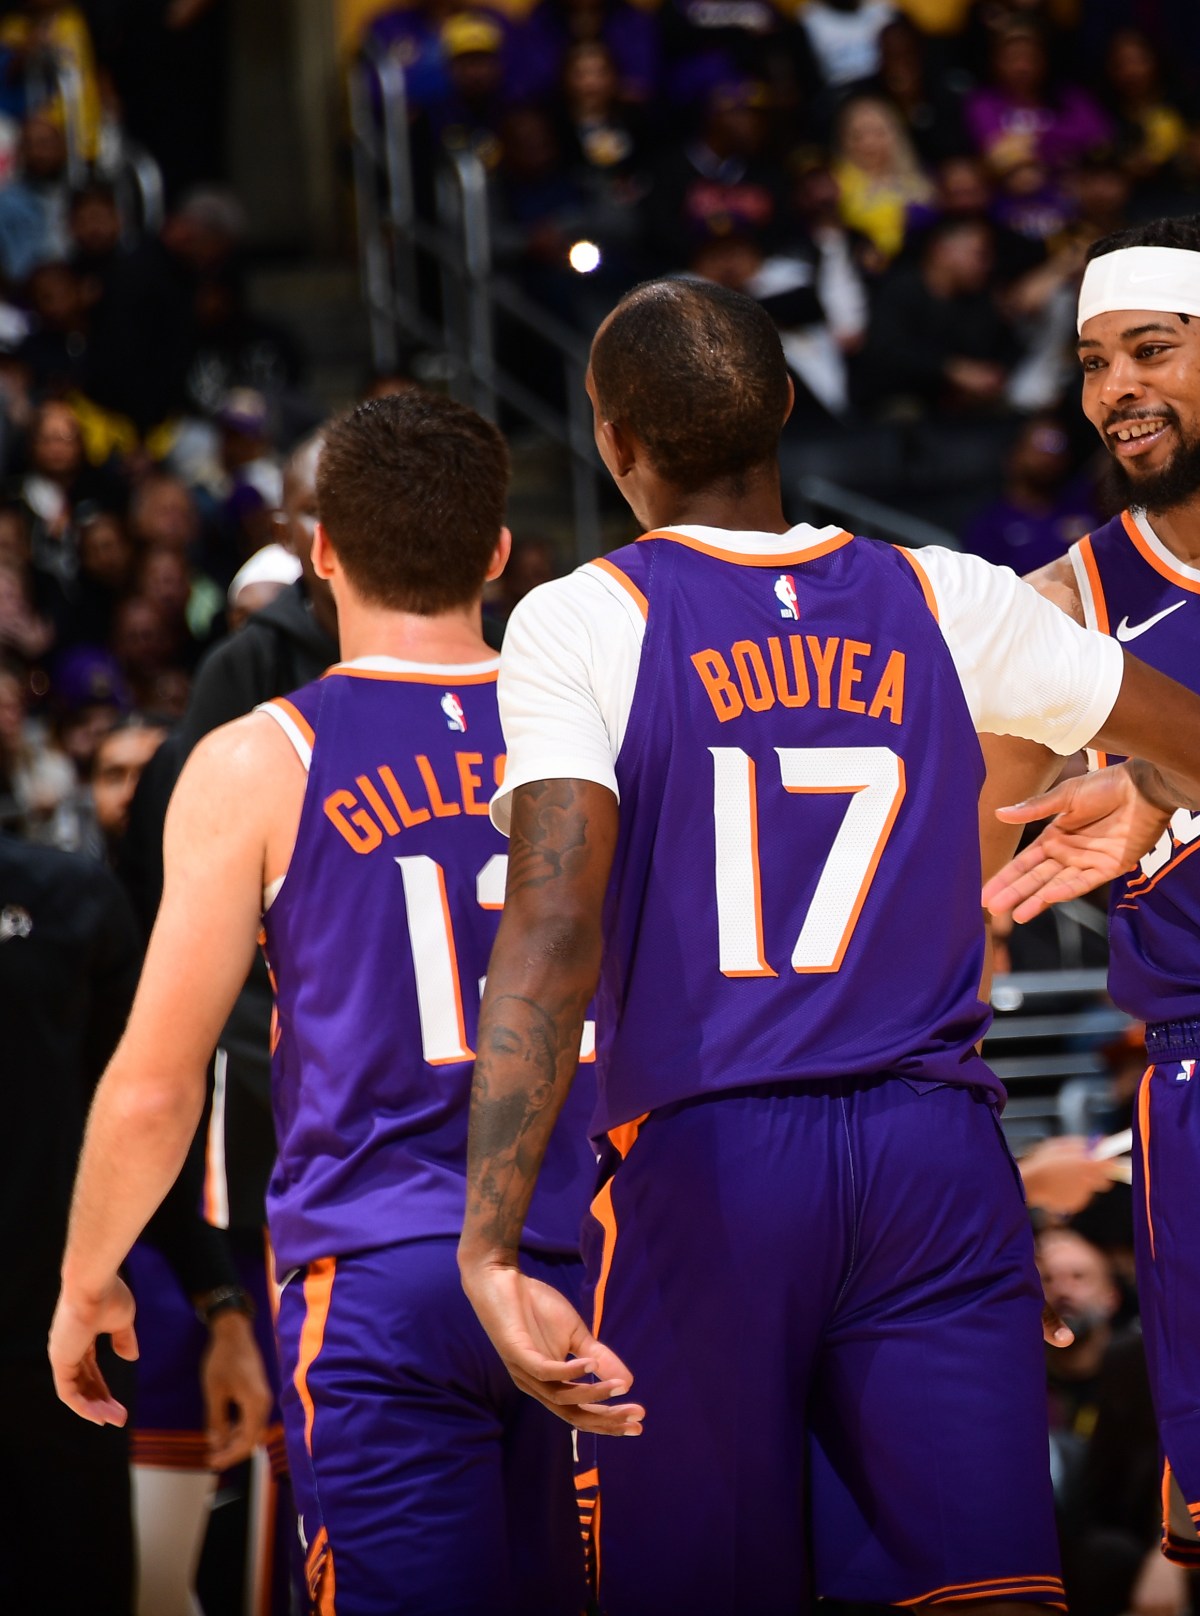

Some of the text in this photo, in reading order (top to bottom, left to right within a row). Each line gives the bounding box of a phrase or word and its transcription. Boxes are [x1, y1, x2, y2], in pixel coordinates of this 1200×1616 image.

[690, 634, 906, 726] BOUYEA
[322, 750, 507, 855] GILLE
[707, 746, 907, 978] 17
